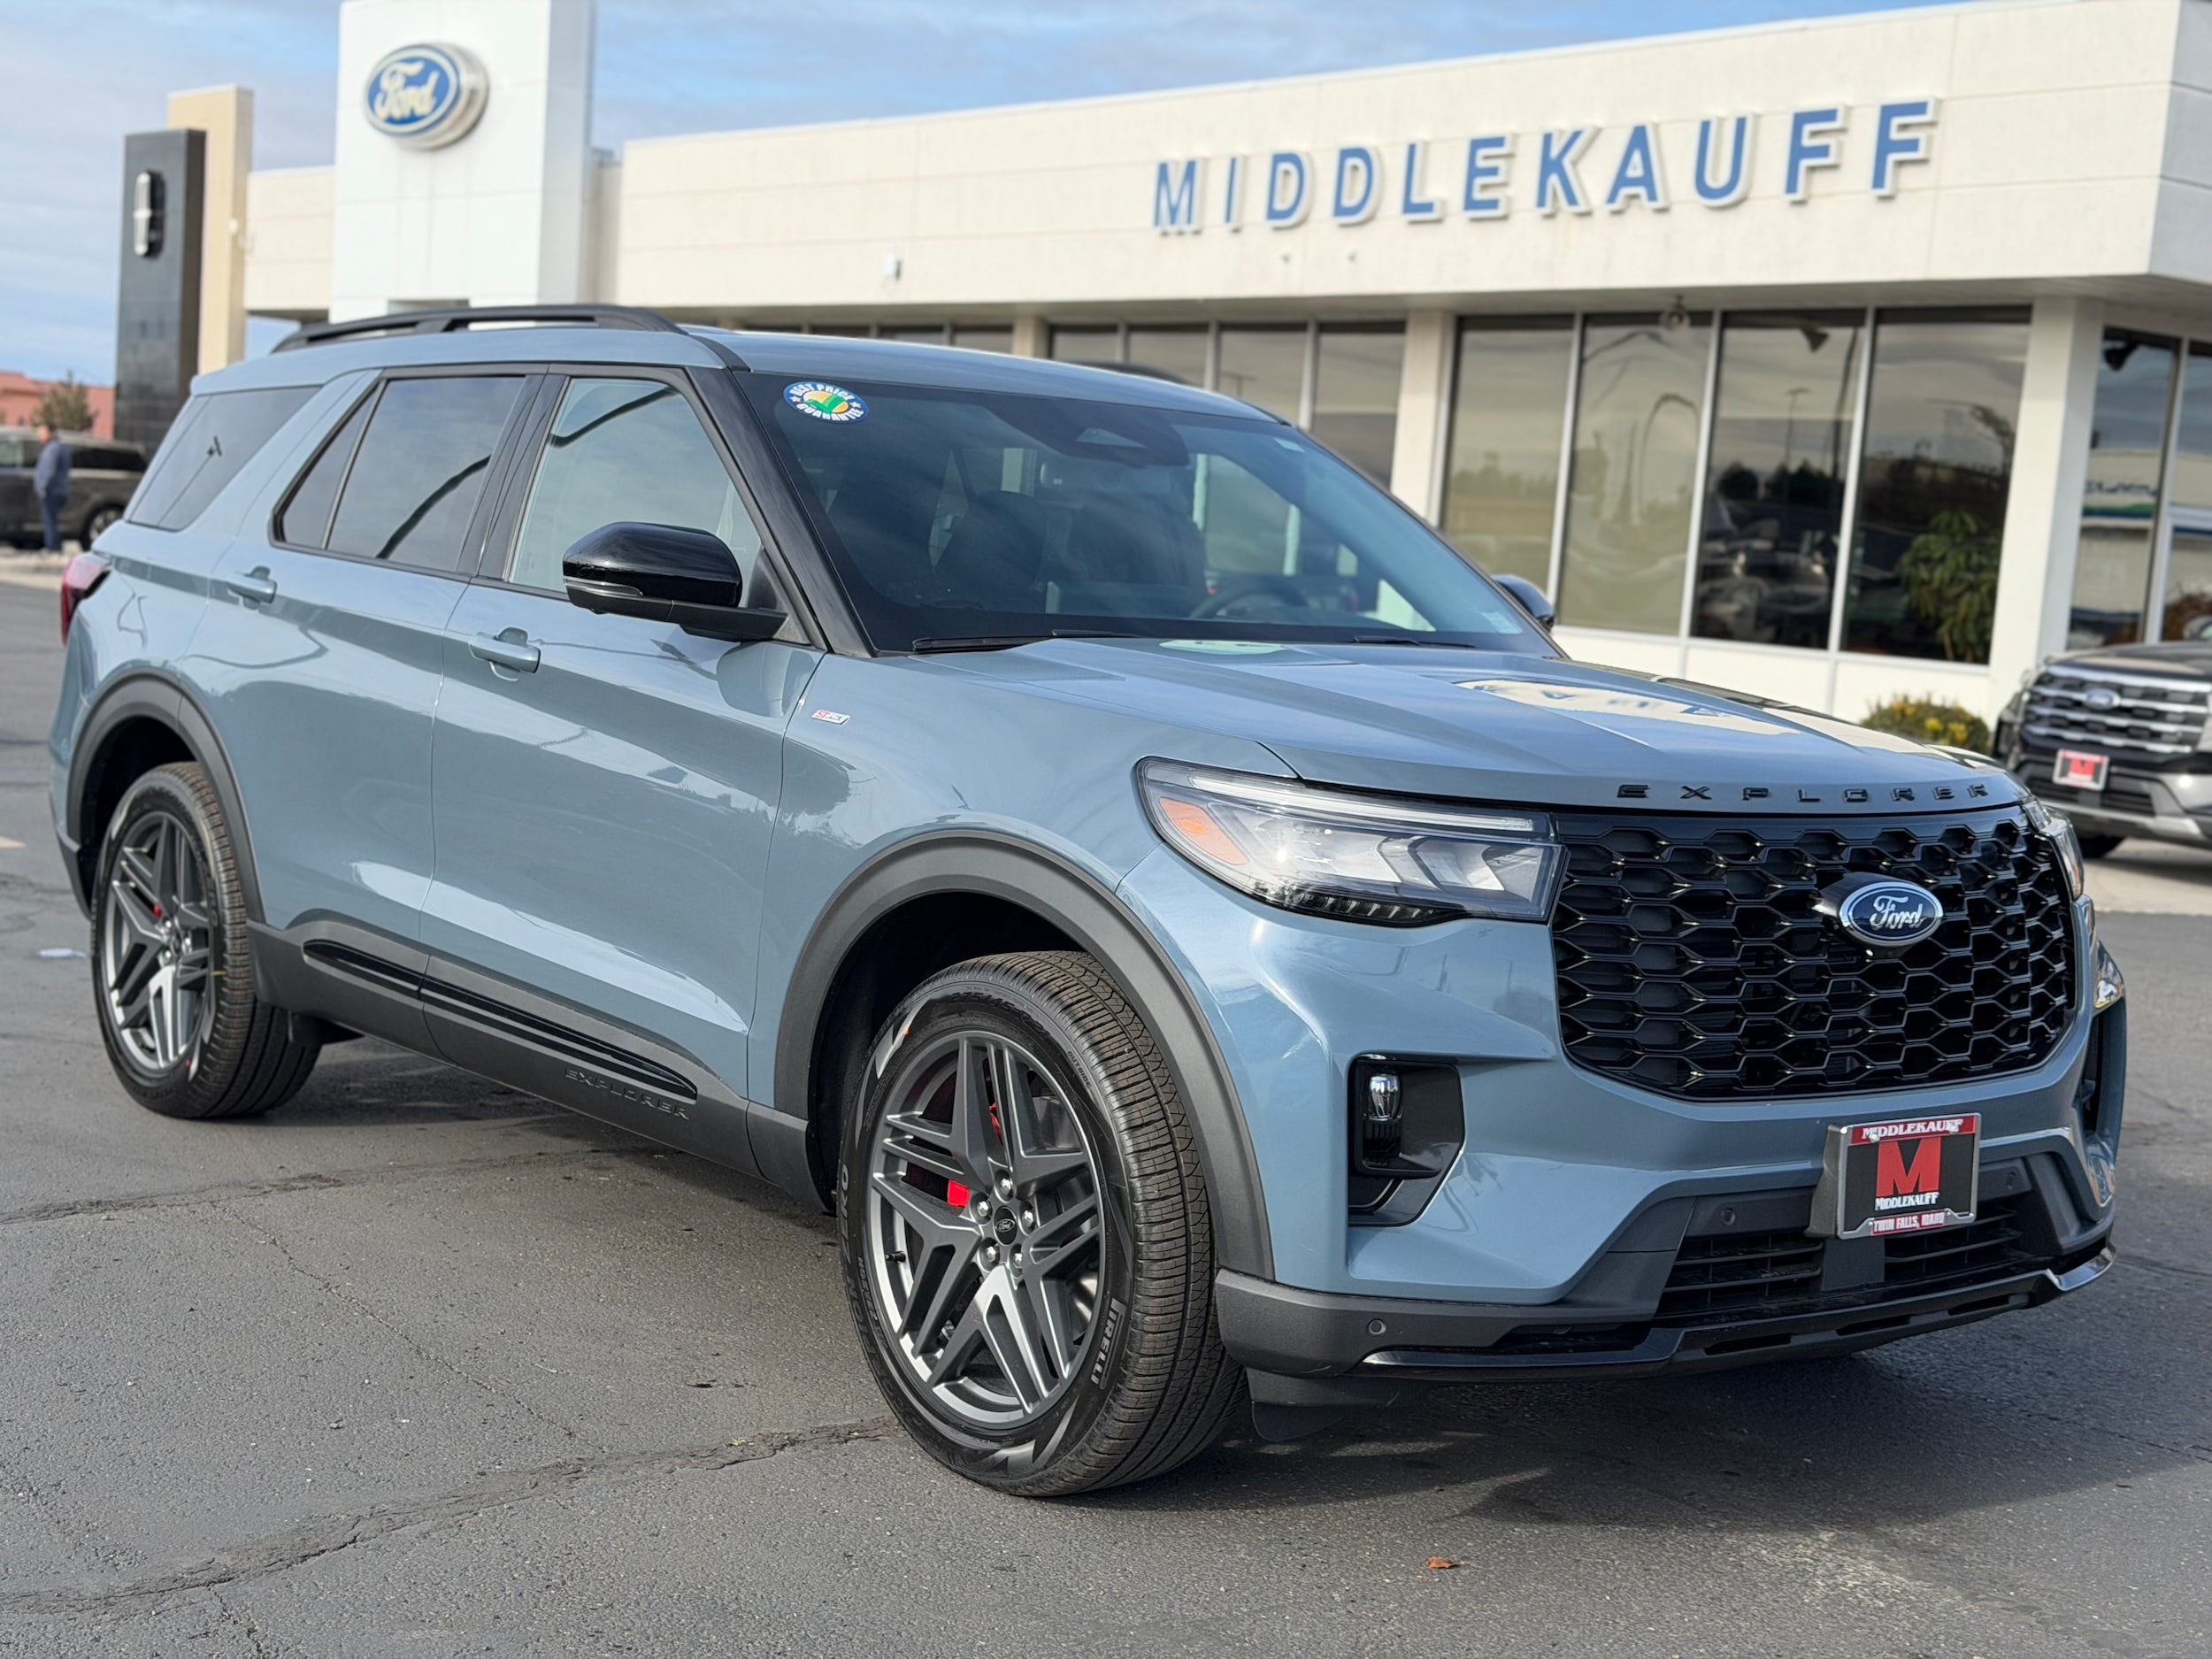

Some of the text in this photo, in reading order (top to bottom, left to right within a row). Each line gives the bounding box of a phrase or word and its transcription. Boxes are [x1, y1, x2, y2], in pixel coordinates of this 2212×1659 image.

[373, 59, 441, 122] Ford
[1153, 99, 1938, 232] MIDDLEKAUFF
[817, 384, 856, 401] PRICE
[1617, 784, 1988, 803] EXPLORER
[1869, 895, 1927, 931] Ford
[565, 1067, 690, 1120] EXPLORER
[1067, 1051, 1092, 1088] OUTSIDE
[1861, 1118, 1963, 1140] MIDDLEKAUFF
[1875, 1136, 1941, 1197] M
[841, 1164, 852, 1263] ZERO
[1090, 1297, 1127, 1390] PIRELLI
